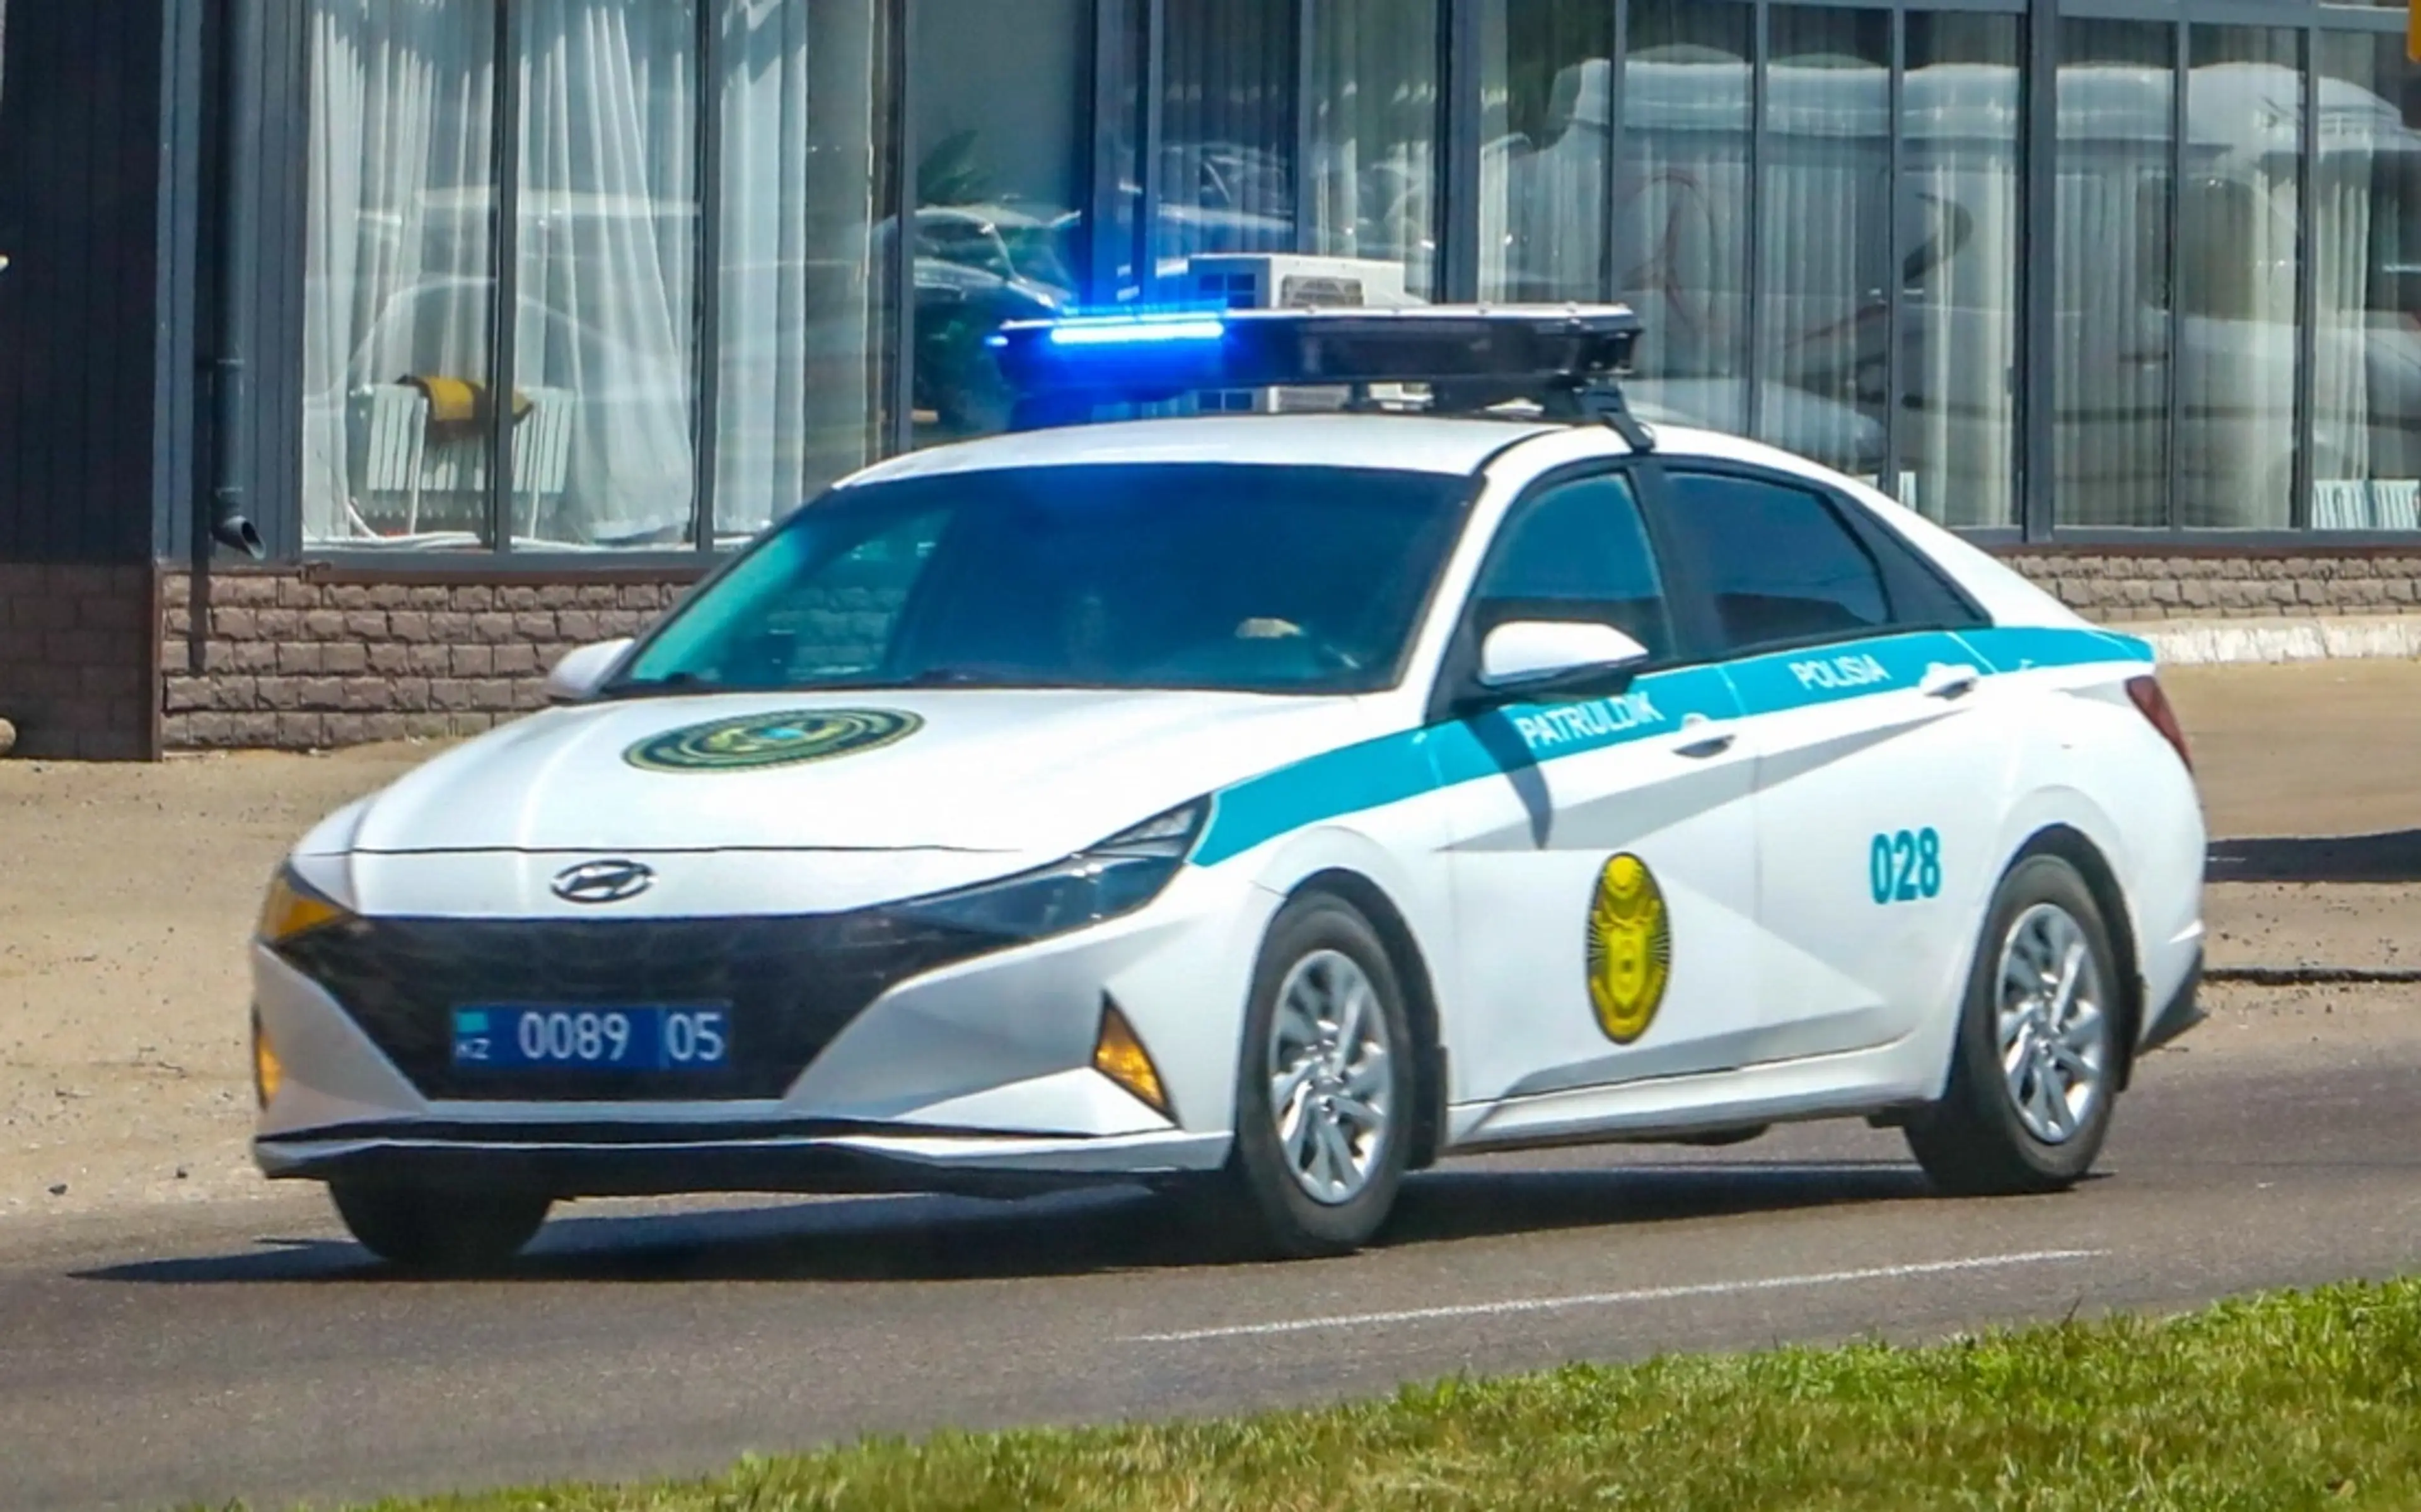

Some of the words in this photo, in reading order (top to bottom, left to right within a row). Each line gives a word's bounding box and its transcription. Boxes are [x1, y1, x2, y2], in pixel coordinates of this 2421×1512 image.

[1787, 653, 1893, 690] POLISIA
[1870, 826, 1941, 905] 028
[518, 1011, 630, 1061] 0089
[666, 1012, 725, 1061] 05
